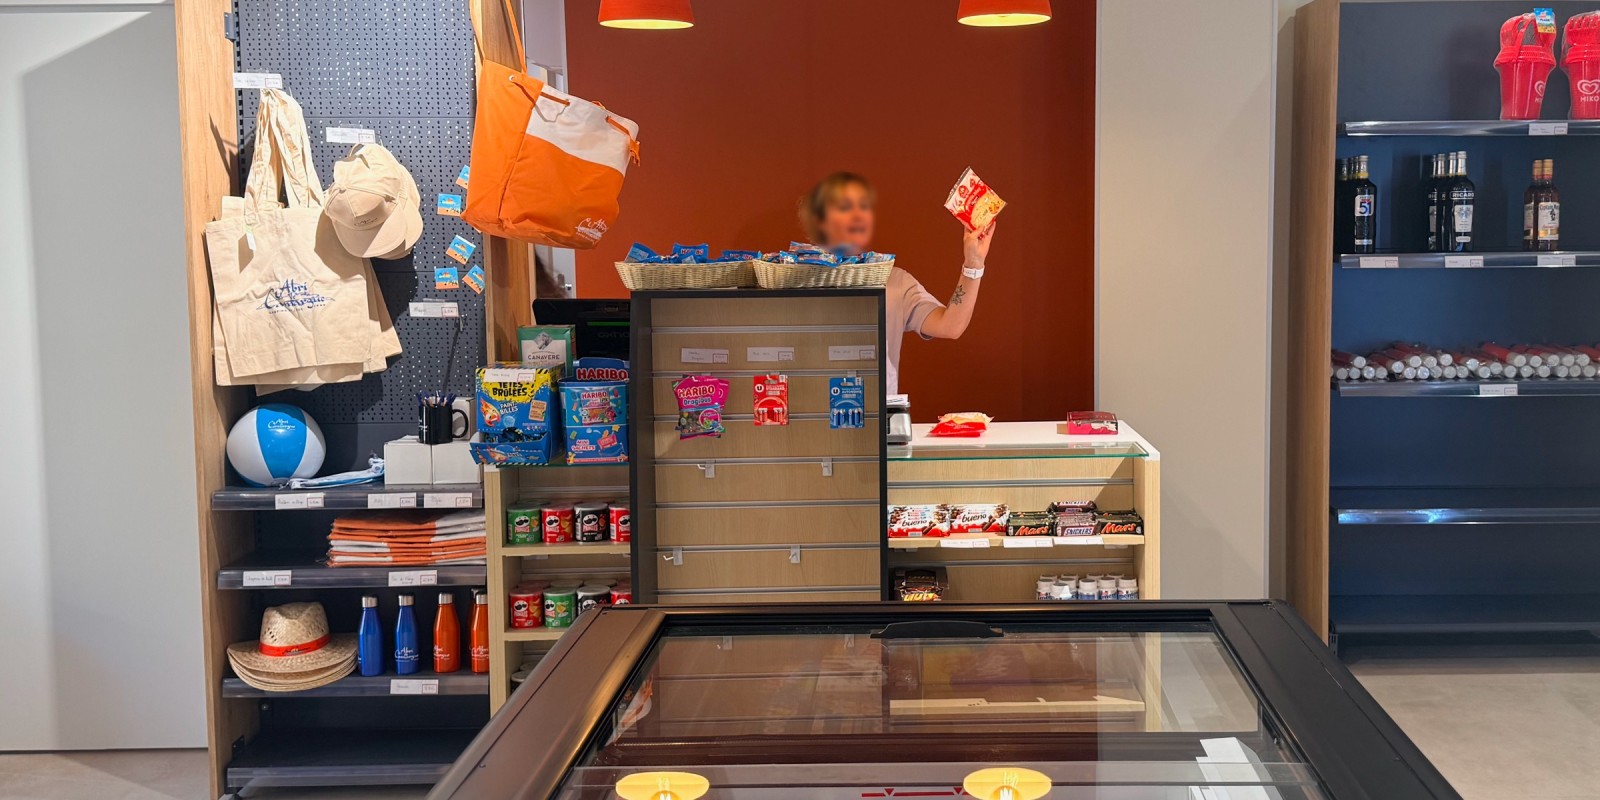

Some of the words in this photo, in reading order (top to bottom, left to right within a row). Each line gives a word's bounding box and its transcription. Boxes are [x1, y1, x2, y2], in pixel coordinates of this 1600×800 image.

[1358, 201, 1372, 215] 51
[576, 368, 629, 380] HARIBO
[581, 390, 608, 399] HARIBO
[678, 385, 716, 398] HARIBO
[683, 397, 712, 406] Dragibus
[961, 513, 987, 523] bueno
[1015, 525, 1049, 536] Mars
[1064, 526, 1095, 536] SNICKERS
[1101, 522, 1137, 534] Mars
